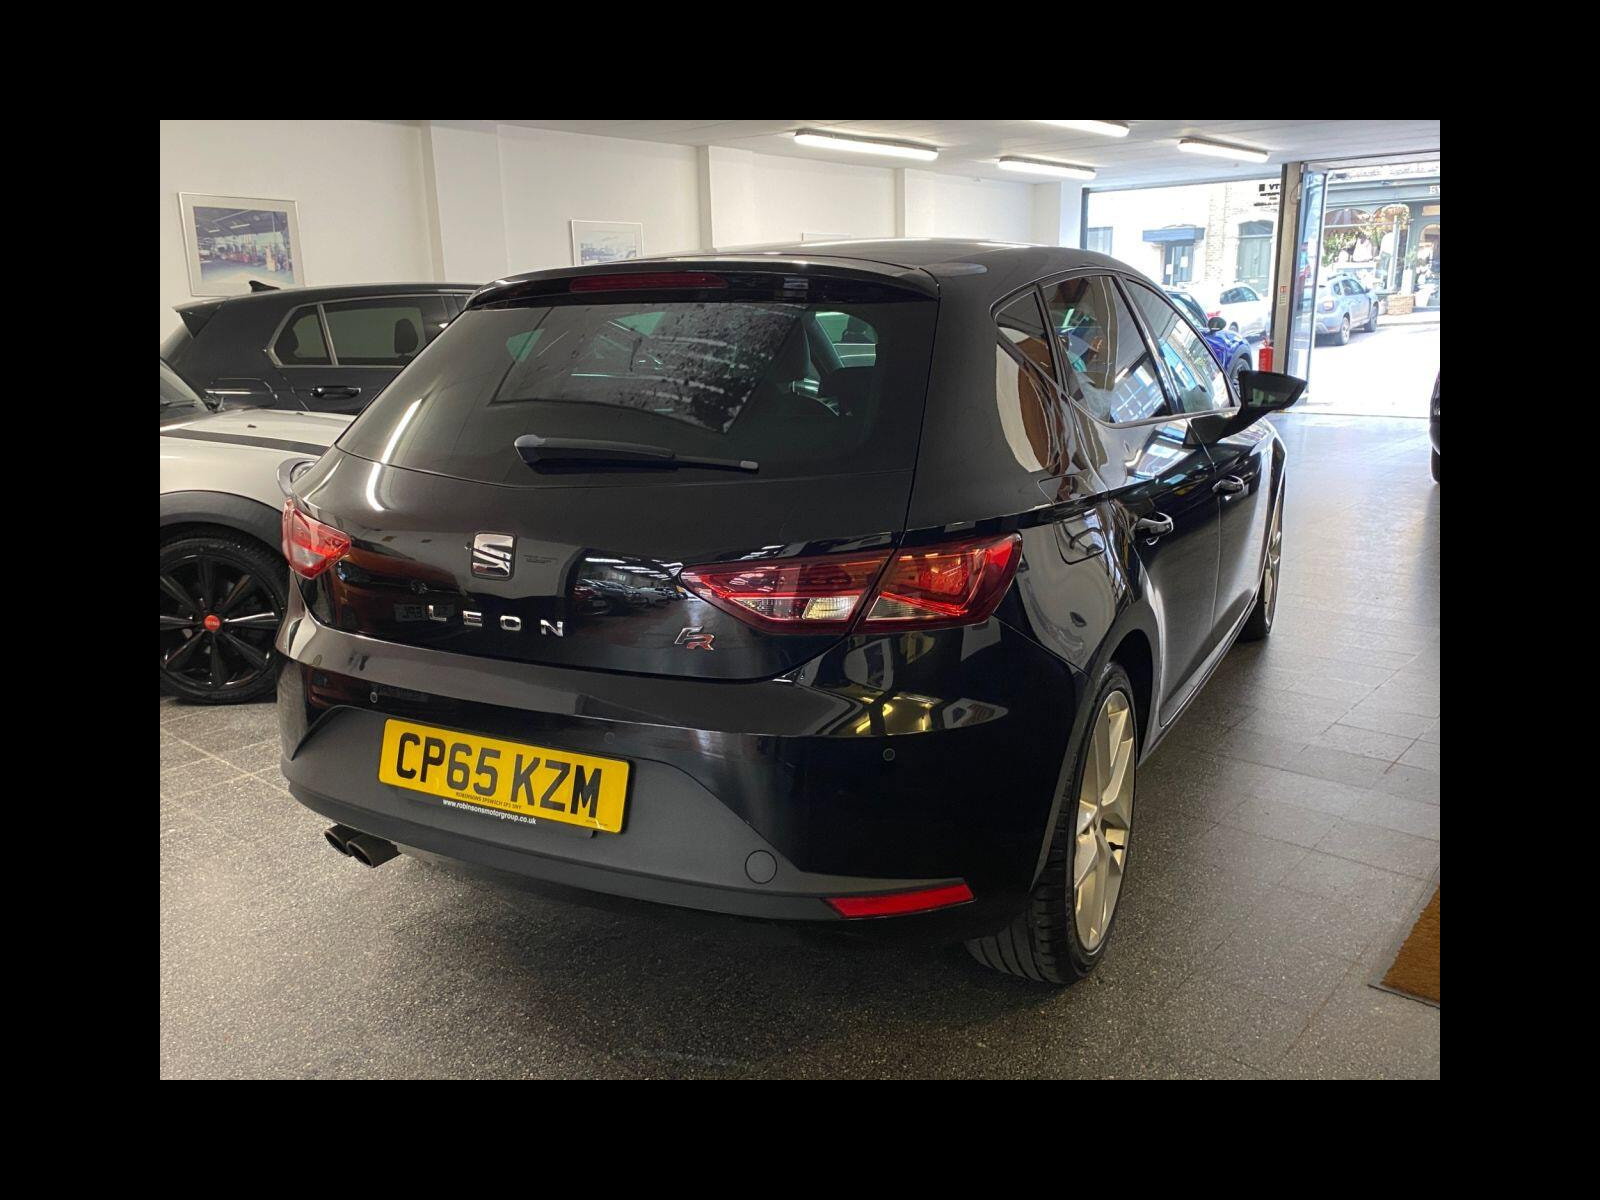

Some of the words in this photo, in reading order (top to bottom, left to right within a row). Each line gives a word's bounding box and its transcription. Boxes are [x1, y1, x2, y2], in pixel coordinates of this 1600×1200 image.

[428, 604, 564, 637] LEON
[674, 625, 715, 651] FR
[396, 732, 501, 796] CP65
[510, 753, 602, 818] KZM
[442, 799, 537, 824] www.robinsonsmotorgroup.co.uk
[455, 791, 482, 802] ROBINSONS
[482, 796, 503, 807] IPSWICH
